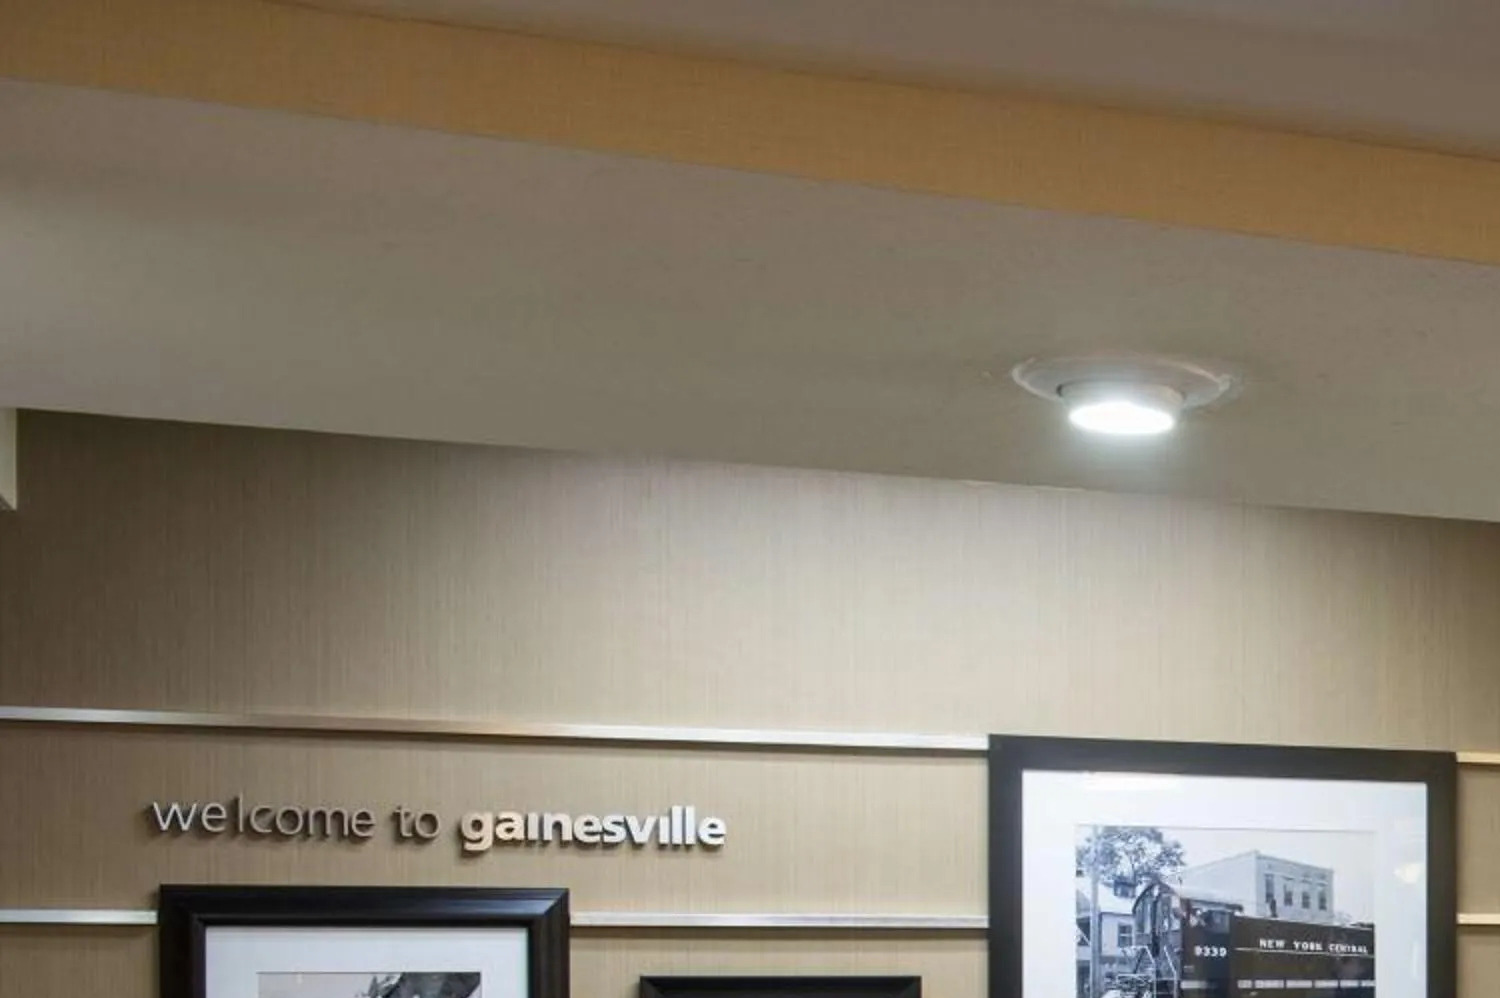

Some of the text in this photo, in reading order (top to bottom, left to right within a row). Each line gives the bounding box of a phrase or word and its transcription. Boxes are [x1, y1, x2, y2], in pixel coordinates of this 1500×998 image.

[152, 791, 725, 851] welcome to gainesville
[1258, 938, 1368, 954] NEW YORK CENTRAL
